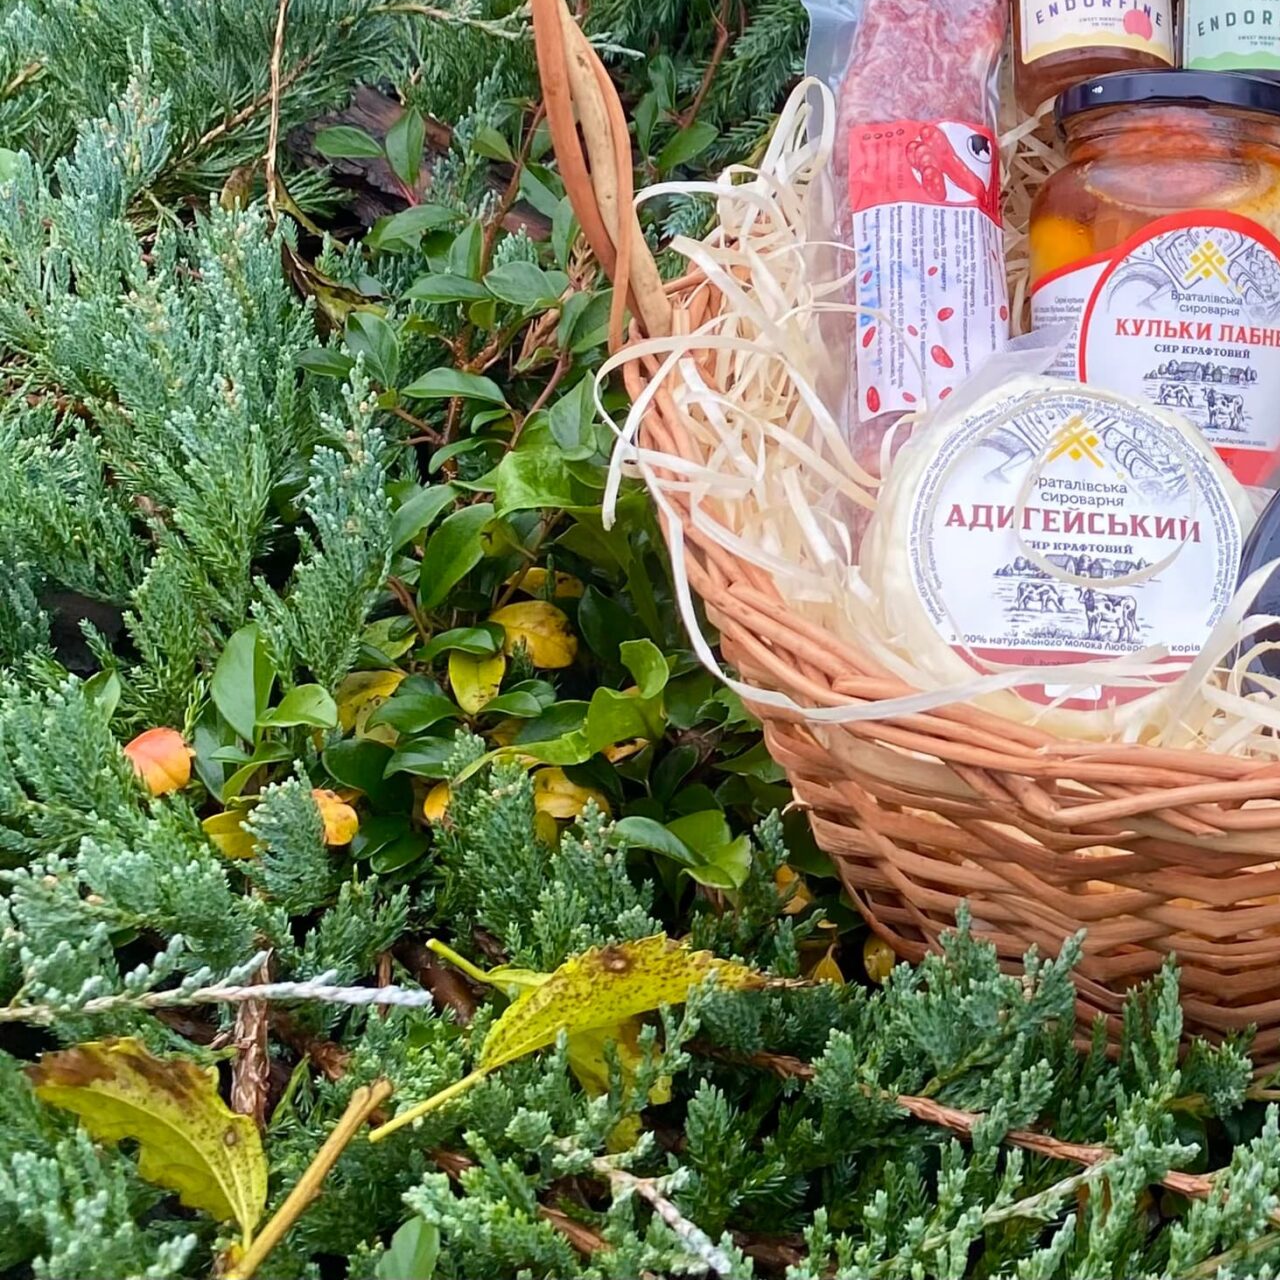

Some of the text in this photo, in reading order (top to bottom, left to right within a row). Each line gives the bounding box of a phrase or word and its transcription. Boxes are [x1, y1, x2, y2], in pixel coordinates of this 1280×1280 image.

[1170, 289, 1243, 307] Браталівська
[1179, 302, 1240, 317] сироварня
[1115, 319, 1213, 342] КУЛЬКИ
[1154, 344, 1251, 360] СИР КРАФТОВИЙ
[1033, 476, 1128, 495] раталівська
[1040, 489, 1125, 507] сироварня
[1053, 542, 1134, 555] КРАФТОВИЙ
[964, 634, 987, 644] 00%
[989, 636, 1062, 647] натурального
[1065, 639, 1103, 651] молока
[1171, 644, 1201, 654] корів
